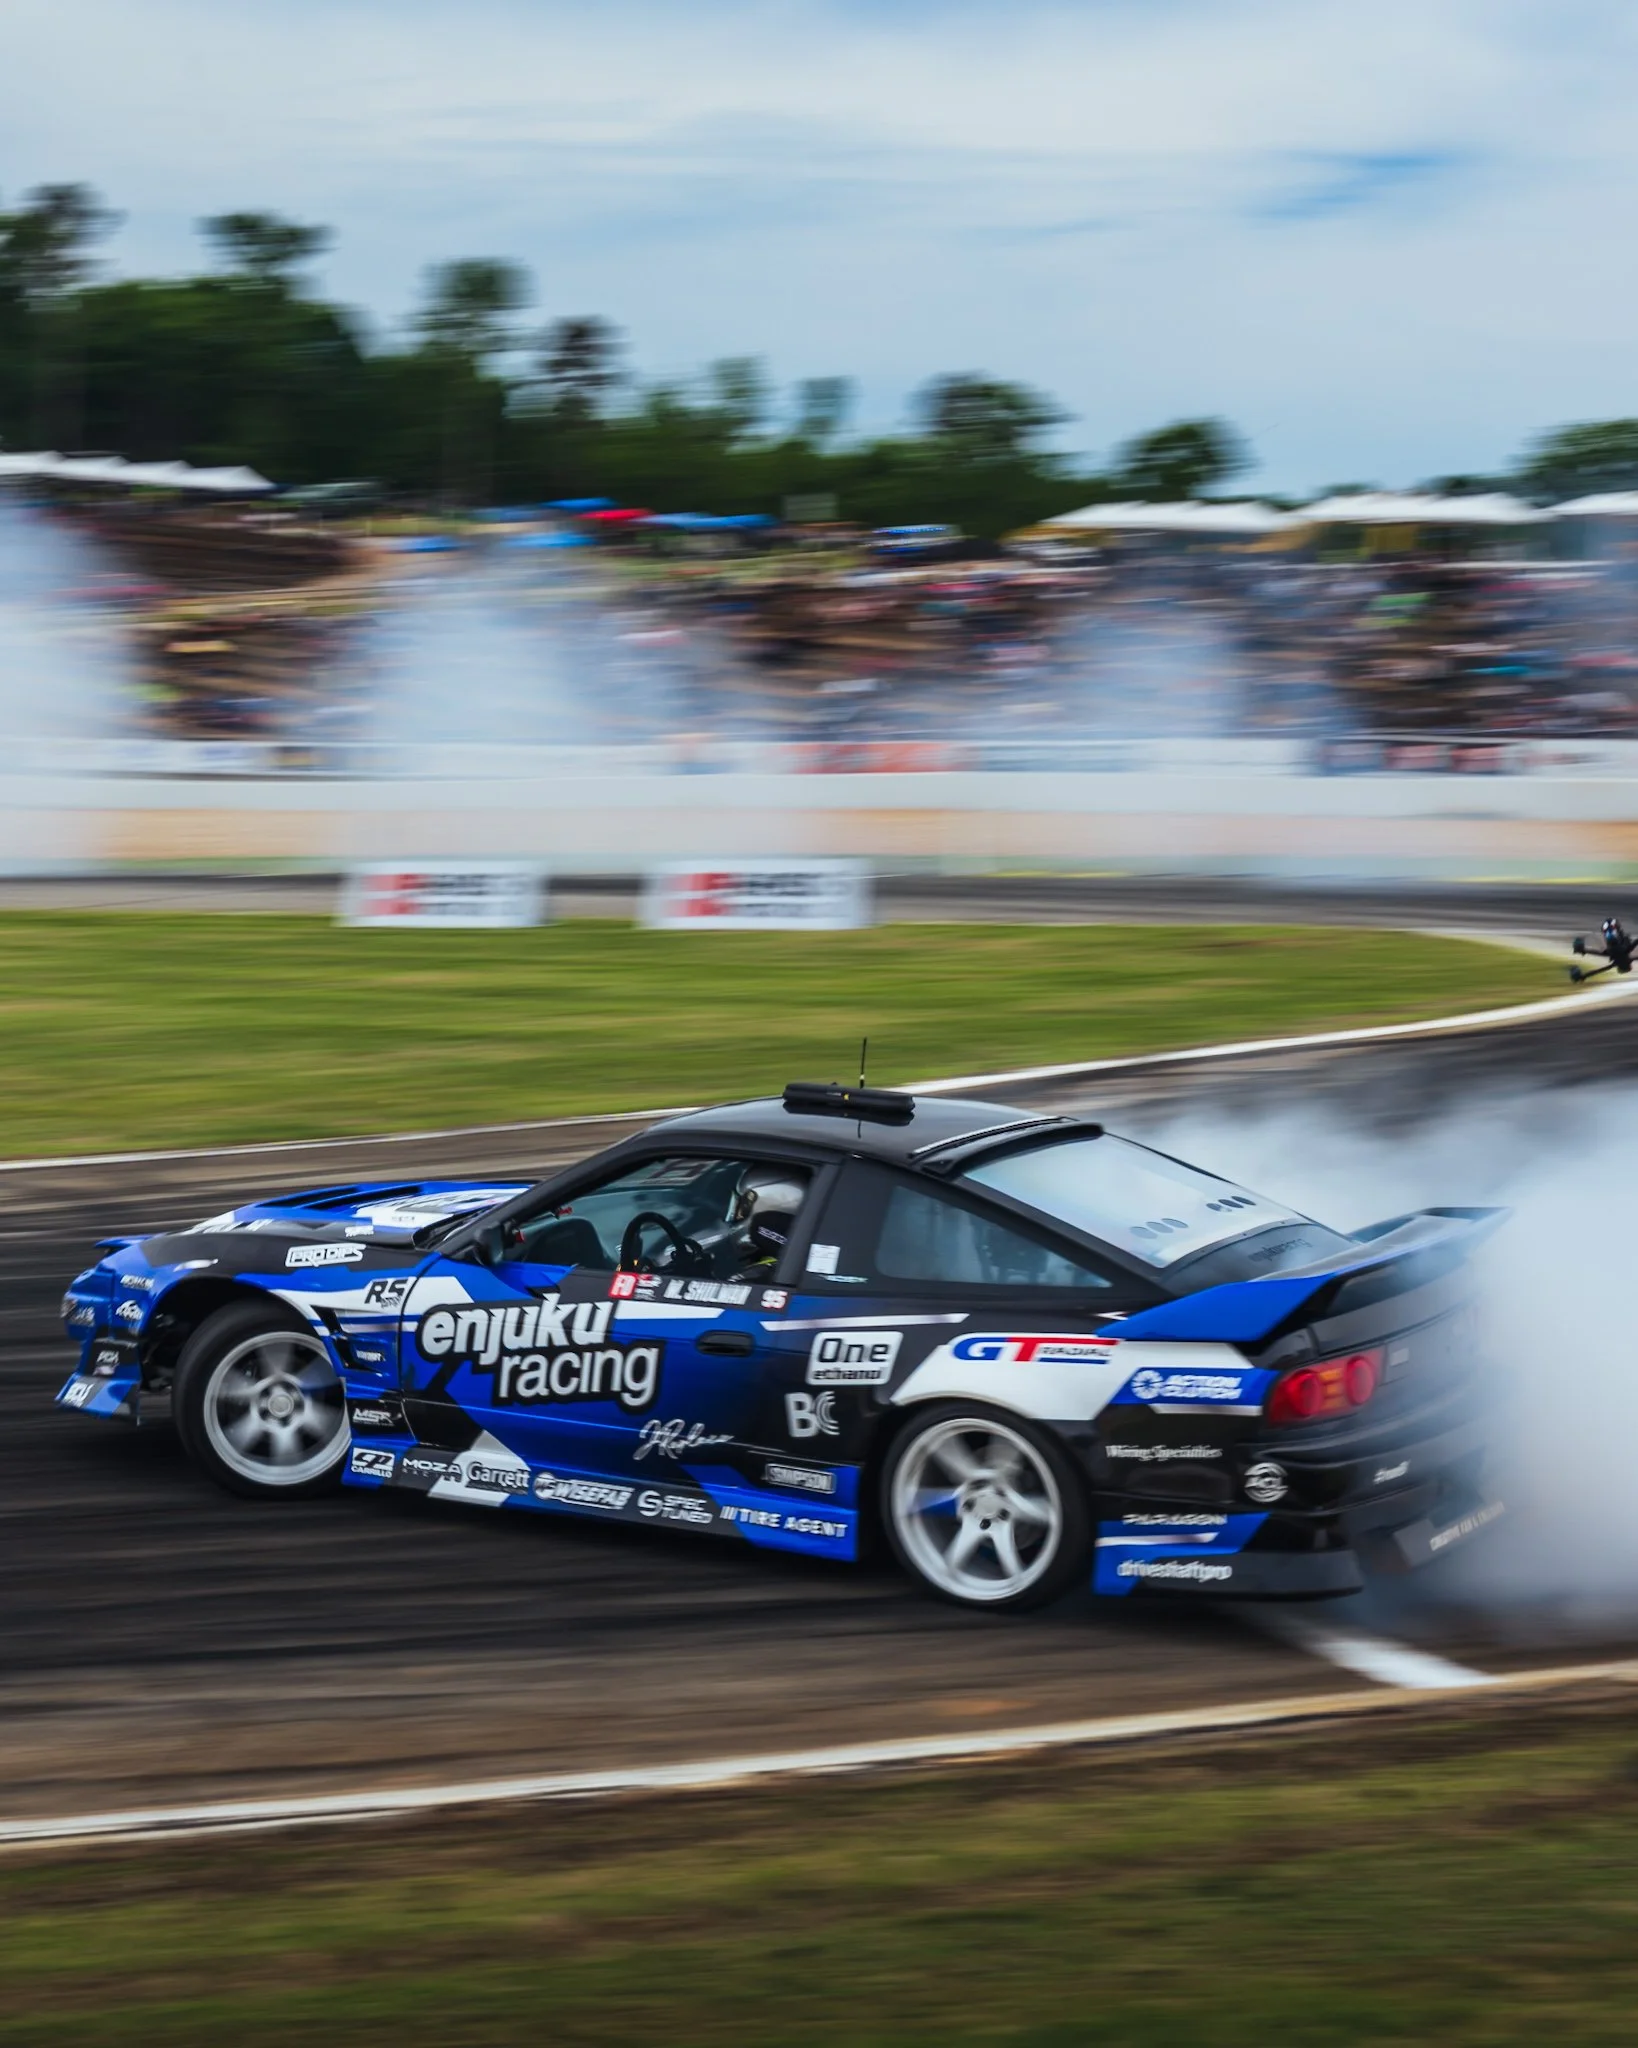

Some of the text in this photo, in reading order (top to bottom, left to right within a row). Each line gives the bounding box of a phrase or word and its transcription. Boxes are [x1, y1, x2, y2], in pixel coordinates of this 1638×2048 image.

[364, 1279, 409, 1304] RS
[422, 1293, 613, 1366] enjuku
[818, 1338, 890, 1363] One
[499, 1347, 660, 1407] racing
[402, 1458, 462, 1475] MOZA
[467, 1461, 531, 1488] Garrett
[739, 1508, 849, 1538] TIRE AGENT
